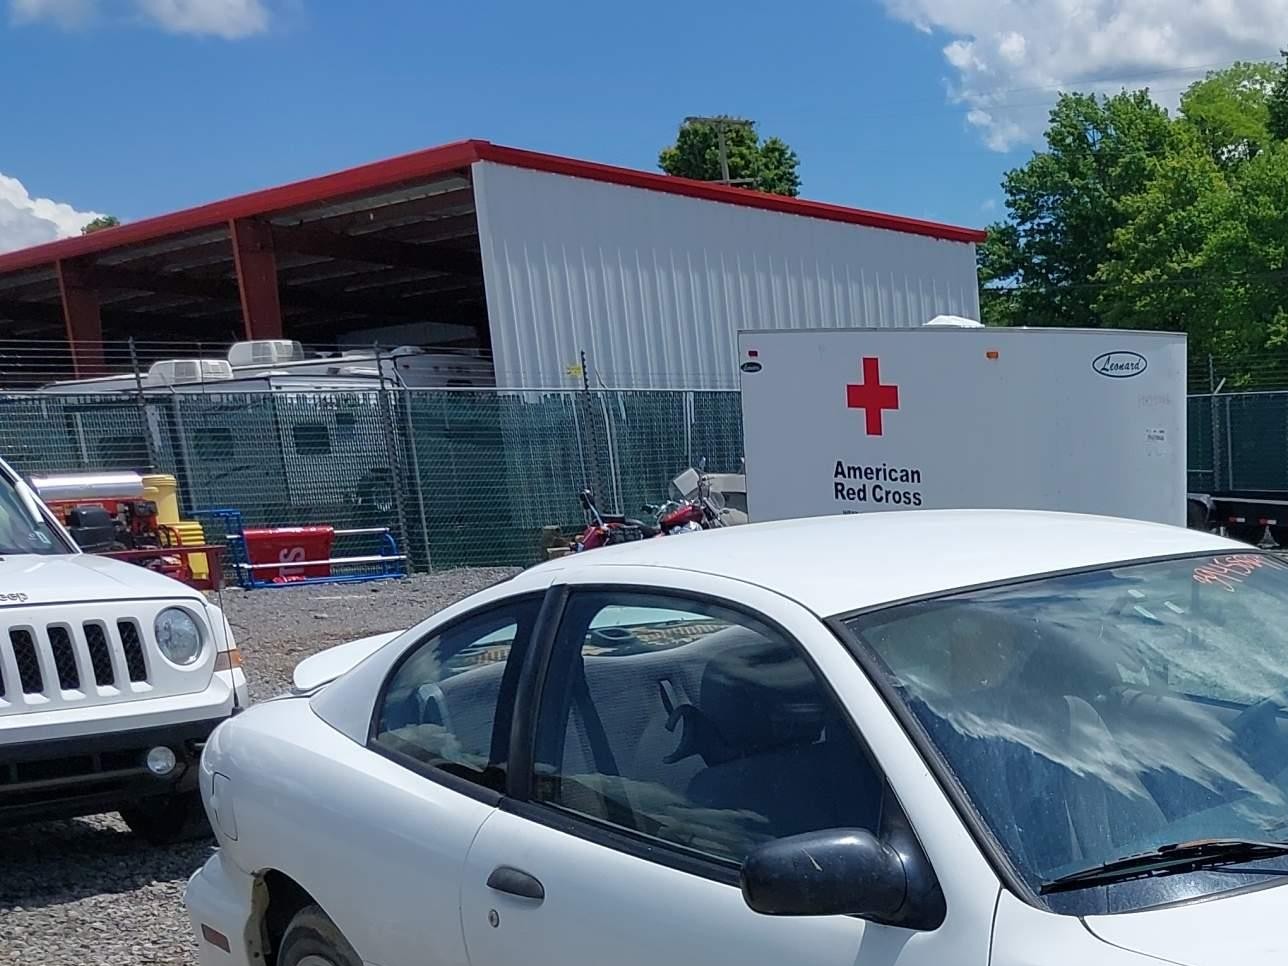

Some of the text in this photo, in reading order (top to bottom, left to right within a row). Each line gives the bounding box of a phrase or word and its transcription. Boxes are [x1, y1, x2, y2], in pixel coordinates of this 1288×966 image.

[1101, 355, 1142, 372] Leonard
[834, 461, 921, 483] American
[834, 482, 922, 506] Red Cross
[0, 593, 29, 602] eep
